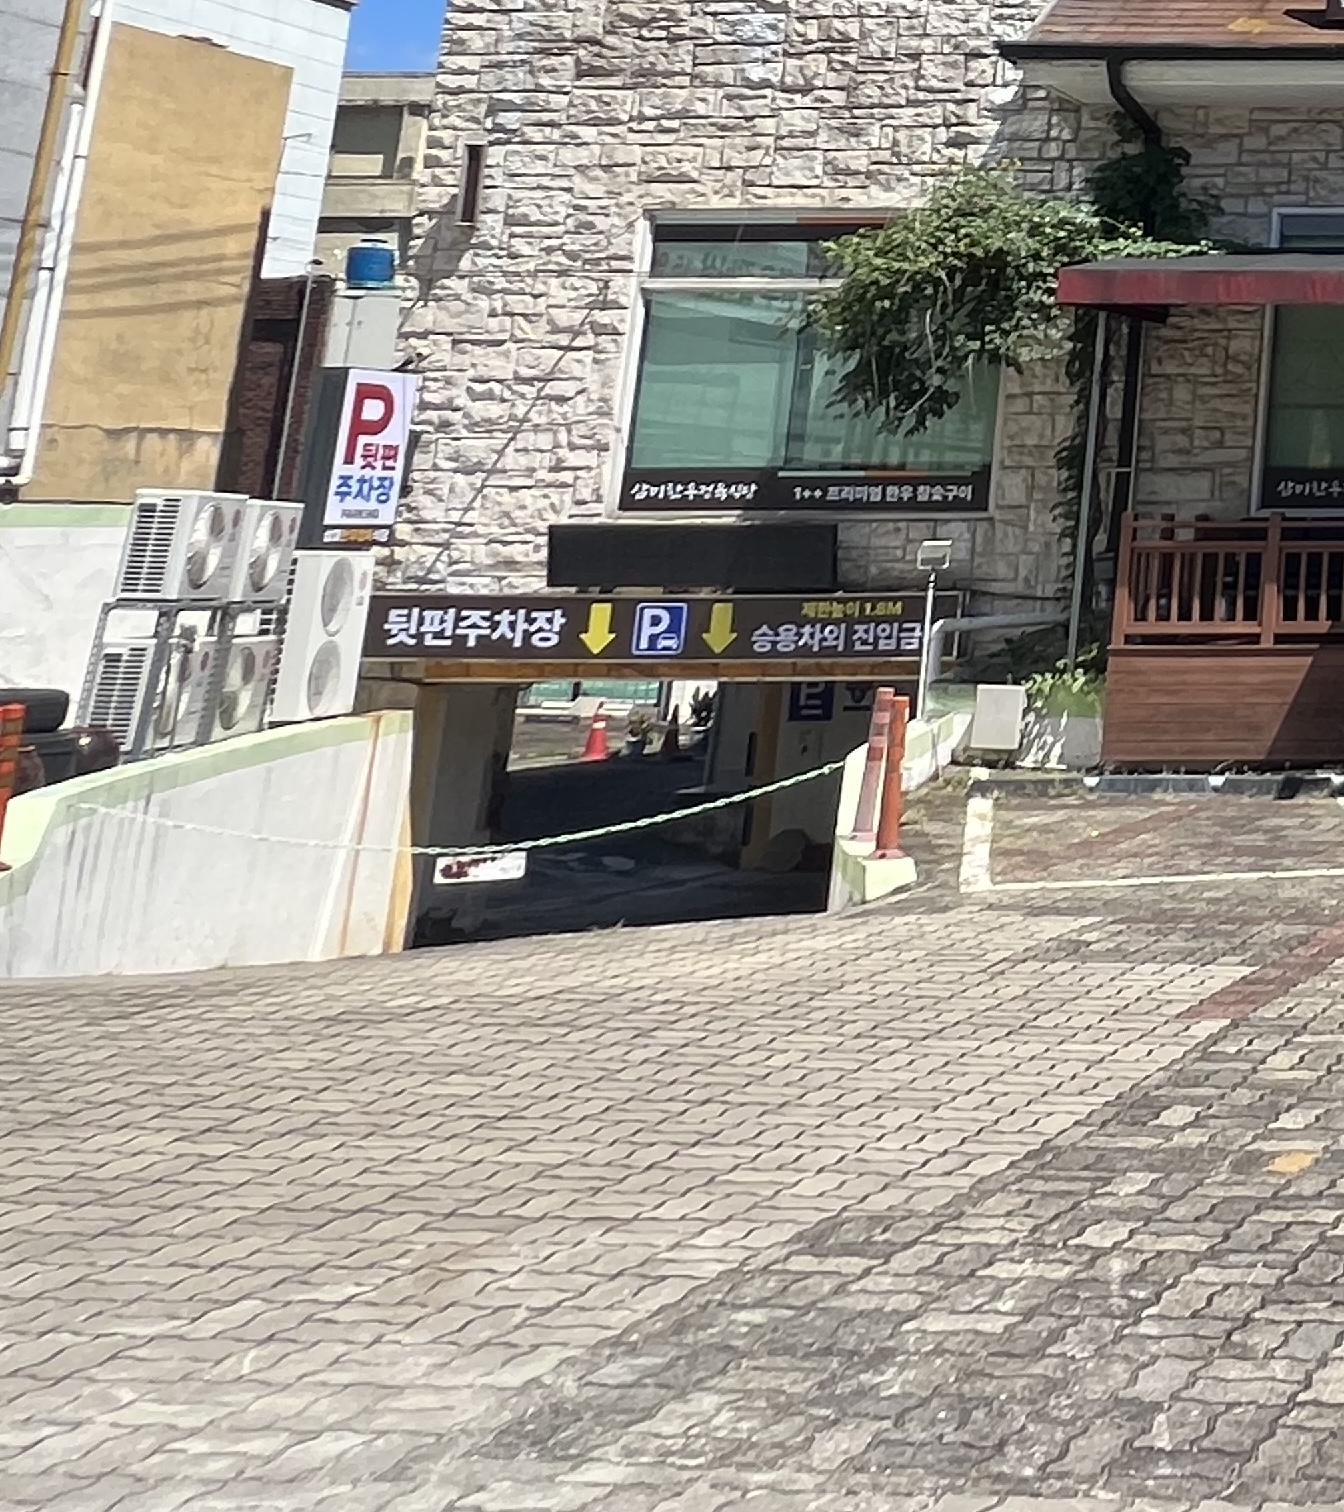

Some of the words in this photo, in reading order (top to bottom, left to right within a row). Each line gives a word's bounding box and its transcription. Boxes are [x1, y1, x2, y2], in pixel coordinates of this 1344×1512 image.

[343, 382, 394, 465] P
[360, 442, 400, 471] 뒷편
[334, 474, 395, 504] 주차장
[383, 607, 567, 648] 뒷편주차장
[751, 620, 848, 652] 승용차외
[852, 620, 924, 651] 진입금
